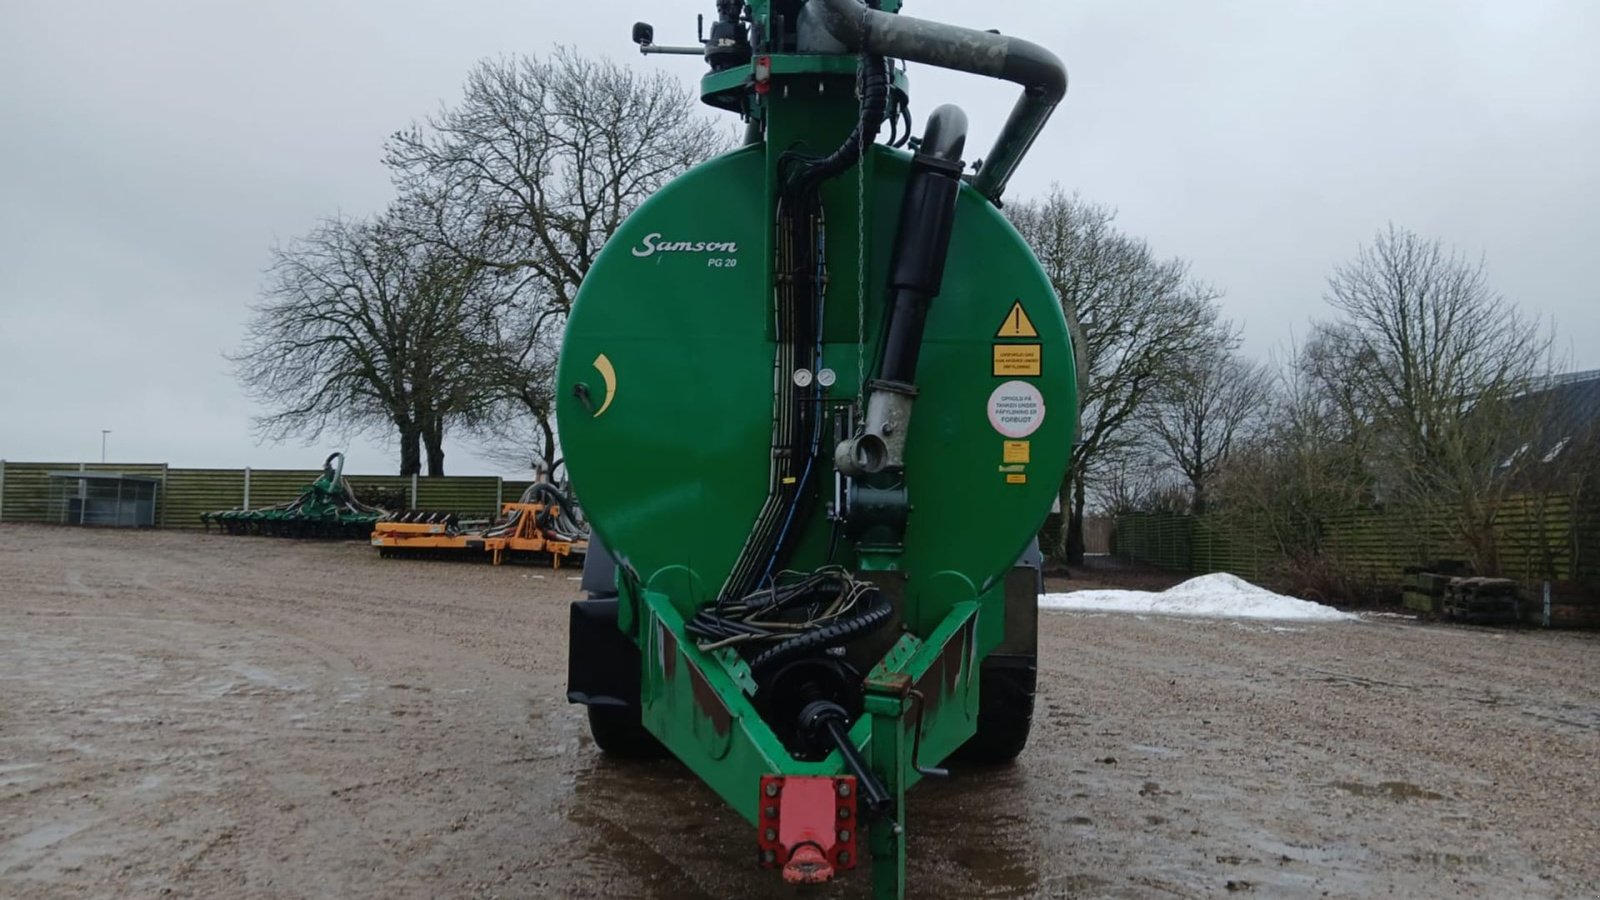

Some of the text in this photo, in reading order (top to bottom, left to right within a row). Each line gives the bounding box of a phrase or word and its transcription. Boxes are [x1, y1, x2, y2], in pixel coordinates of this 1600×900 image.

[632, 233, 737, 257] Samson
[708, 258, 737, 267] PG 20
